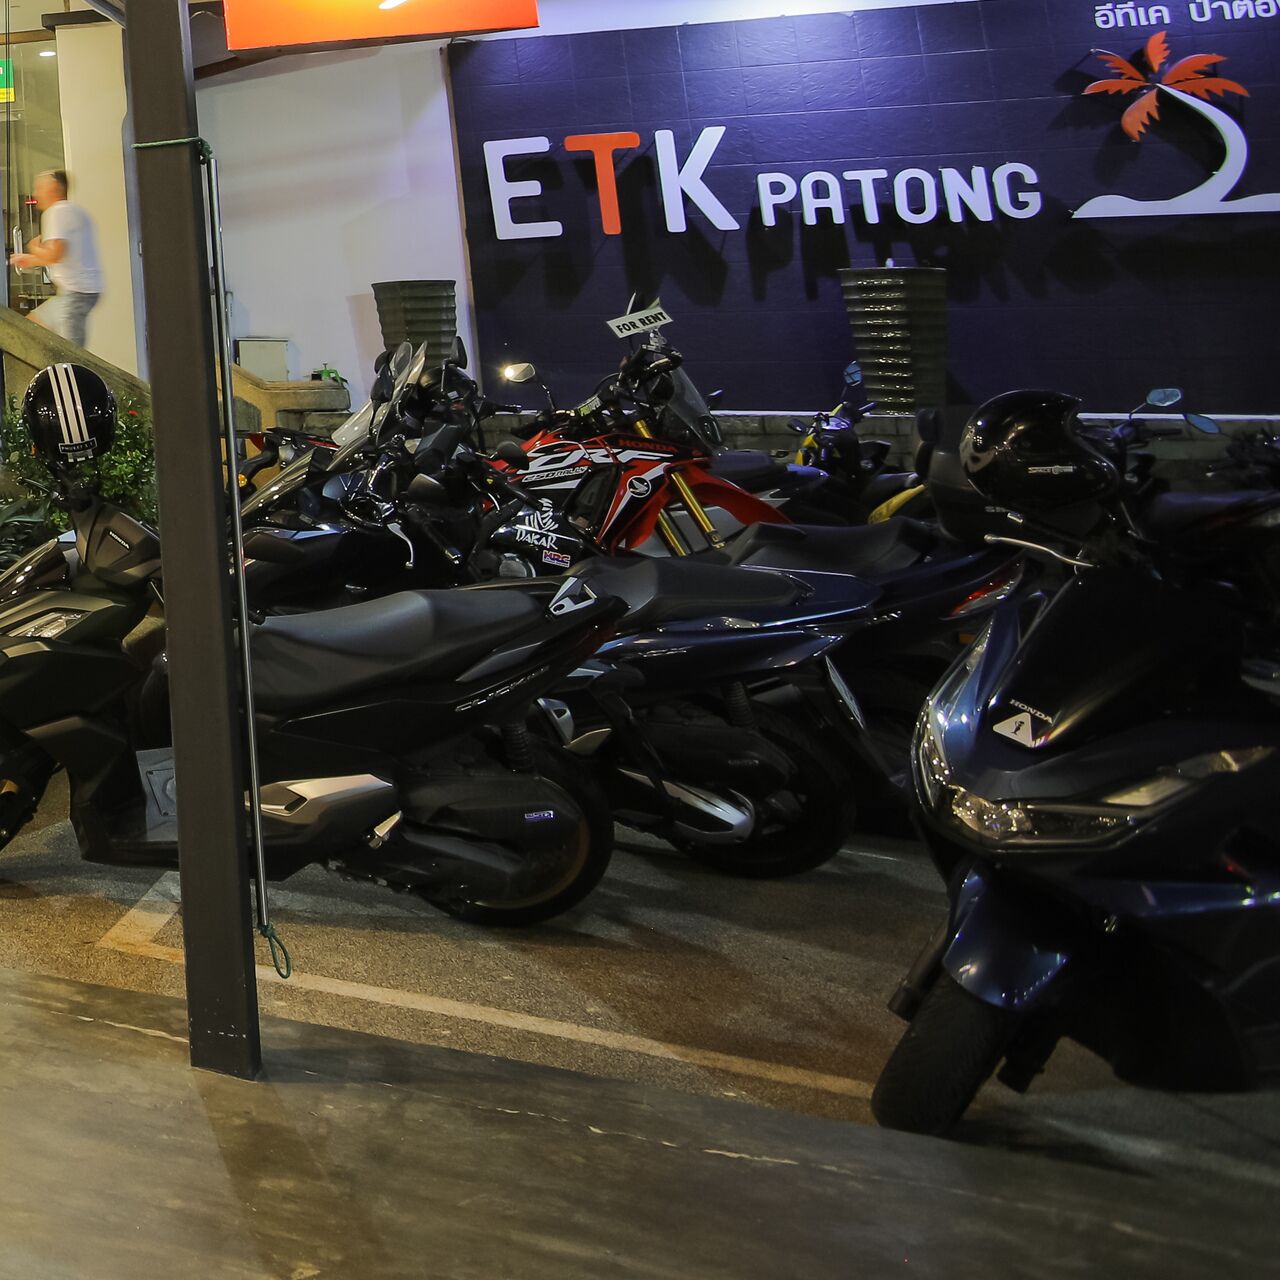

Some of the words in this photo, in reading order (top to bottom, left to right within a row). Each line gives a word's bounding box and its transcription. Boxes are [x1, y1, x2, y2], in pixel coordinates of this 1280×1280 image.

[1094, 1, 1171, 29] อีทีเค
[483, 125, 740, 241] ETK
[757, 162, 1041, 227] PATONG
[616, 321, 640, 333] FOR
[638, 311, 667, 326] RENT
[618, 438, 680, 453] HONDA
[516, 529, 558, 550] DAKAR
[1009, 699, 1053, 724] HONDA
